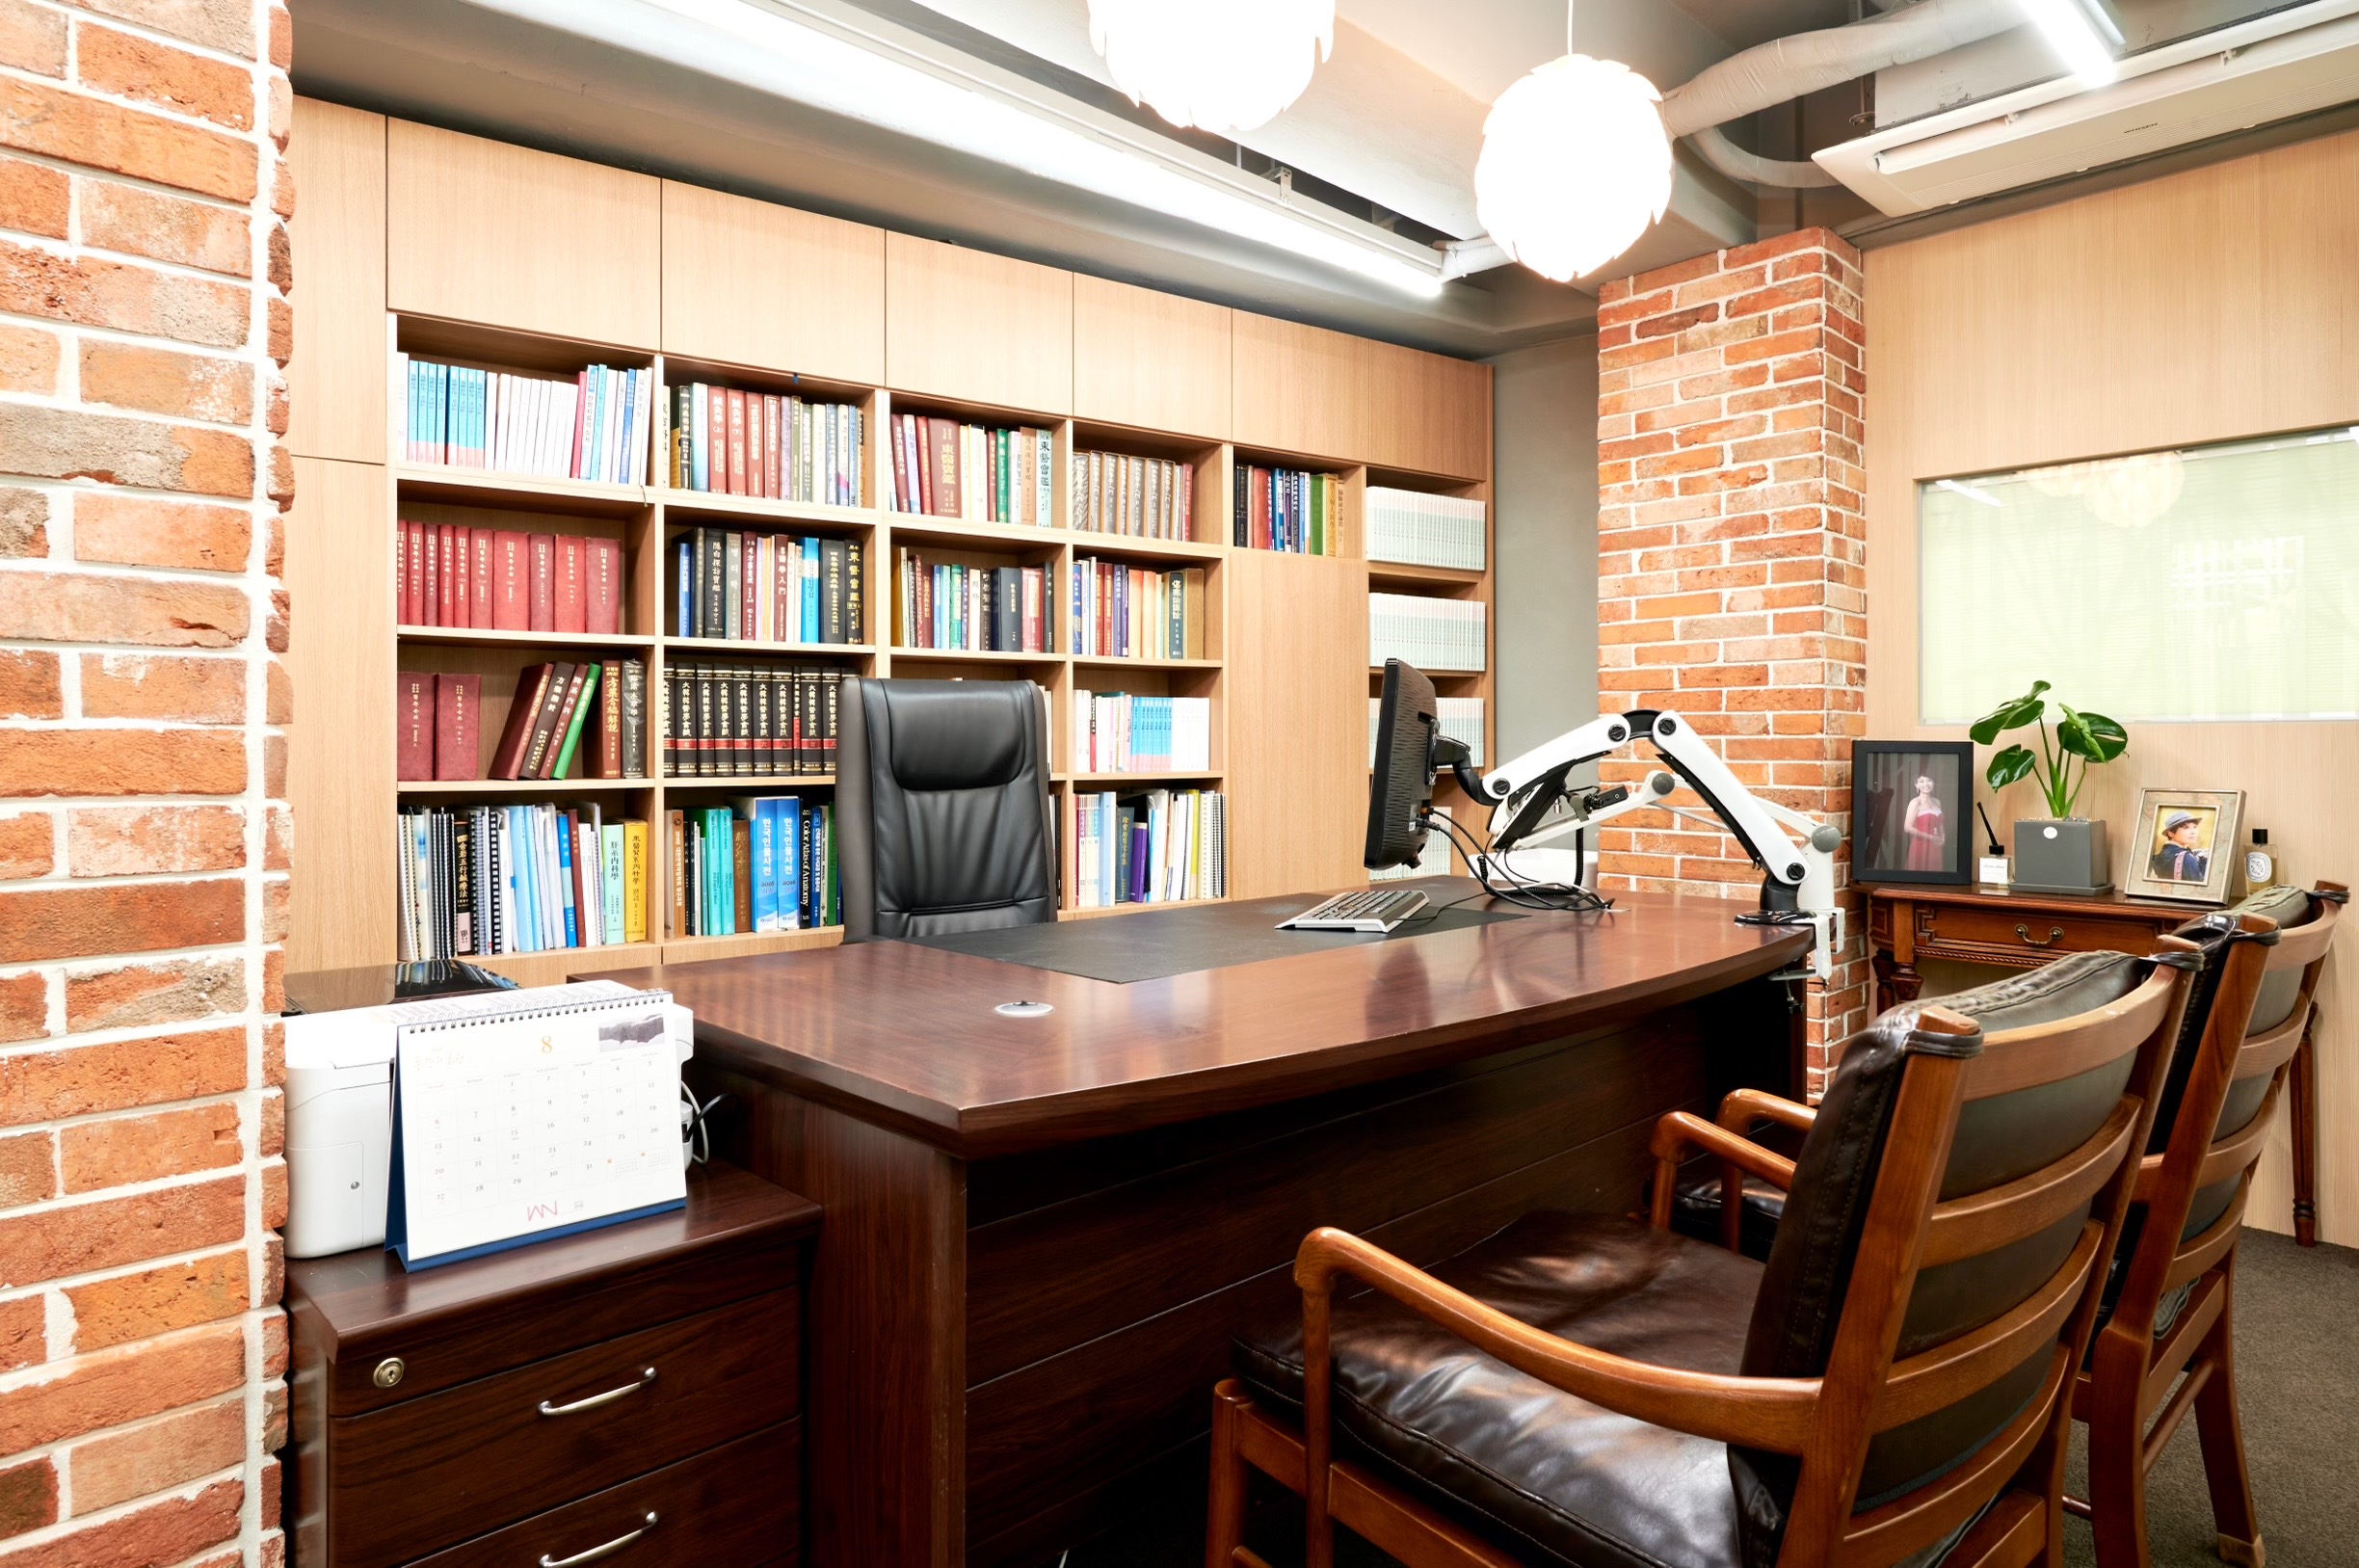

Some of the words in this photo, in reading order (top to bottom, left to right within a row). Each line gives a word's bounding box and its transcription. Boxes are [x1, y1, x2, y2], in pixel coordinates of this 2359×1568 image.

[848, 552, 860, 601] 東醫寶鑑
[801, 871, 810, 906] Anatomy
[542, 1035, 552, 1053] 8
